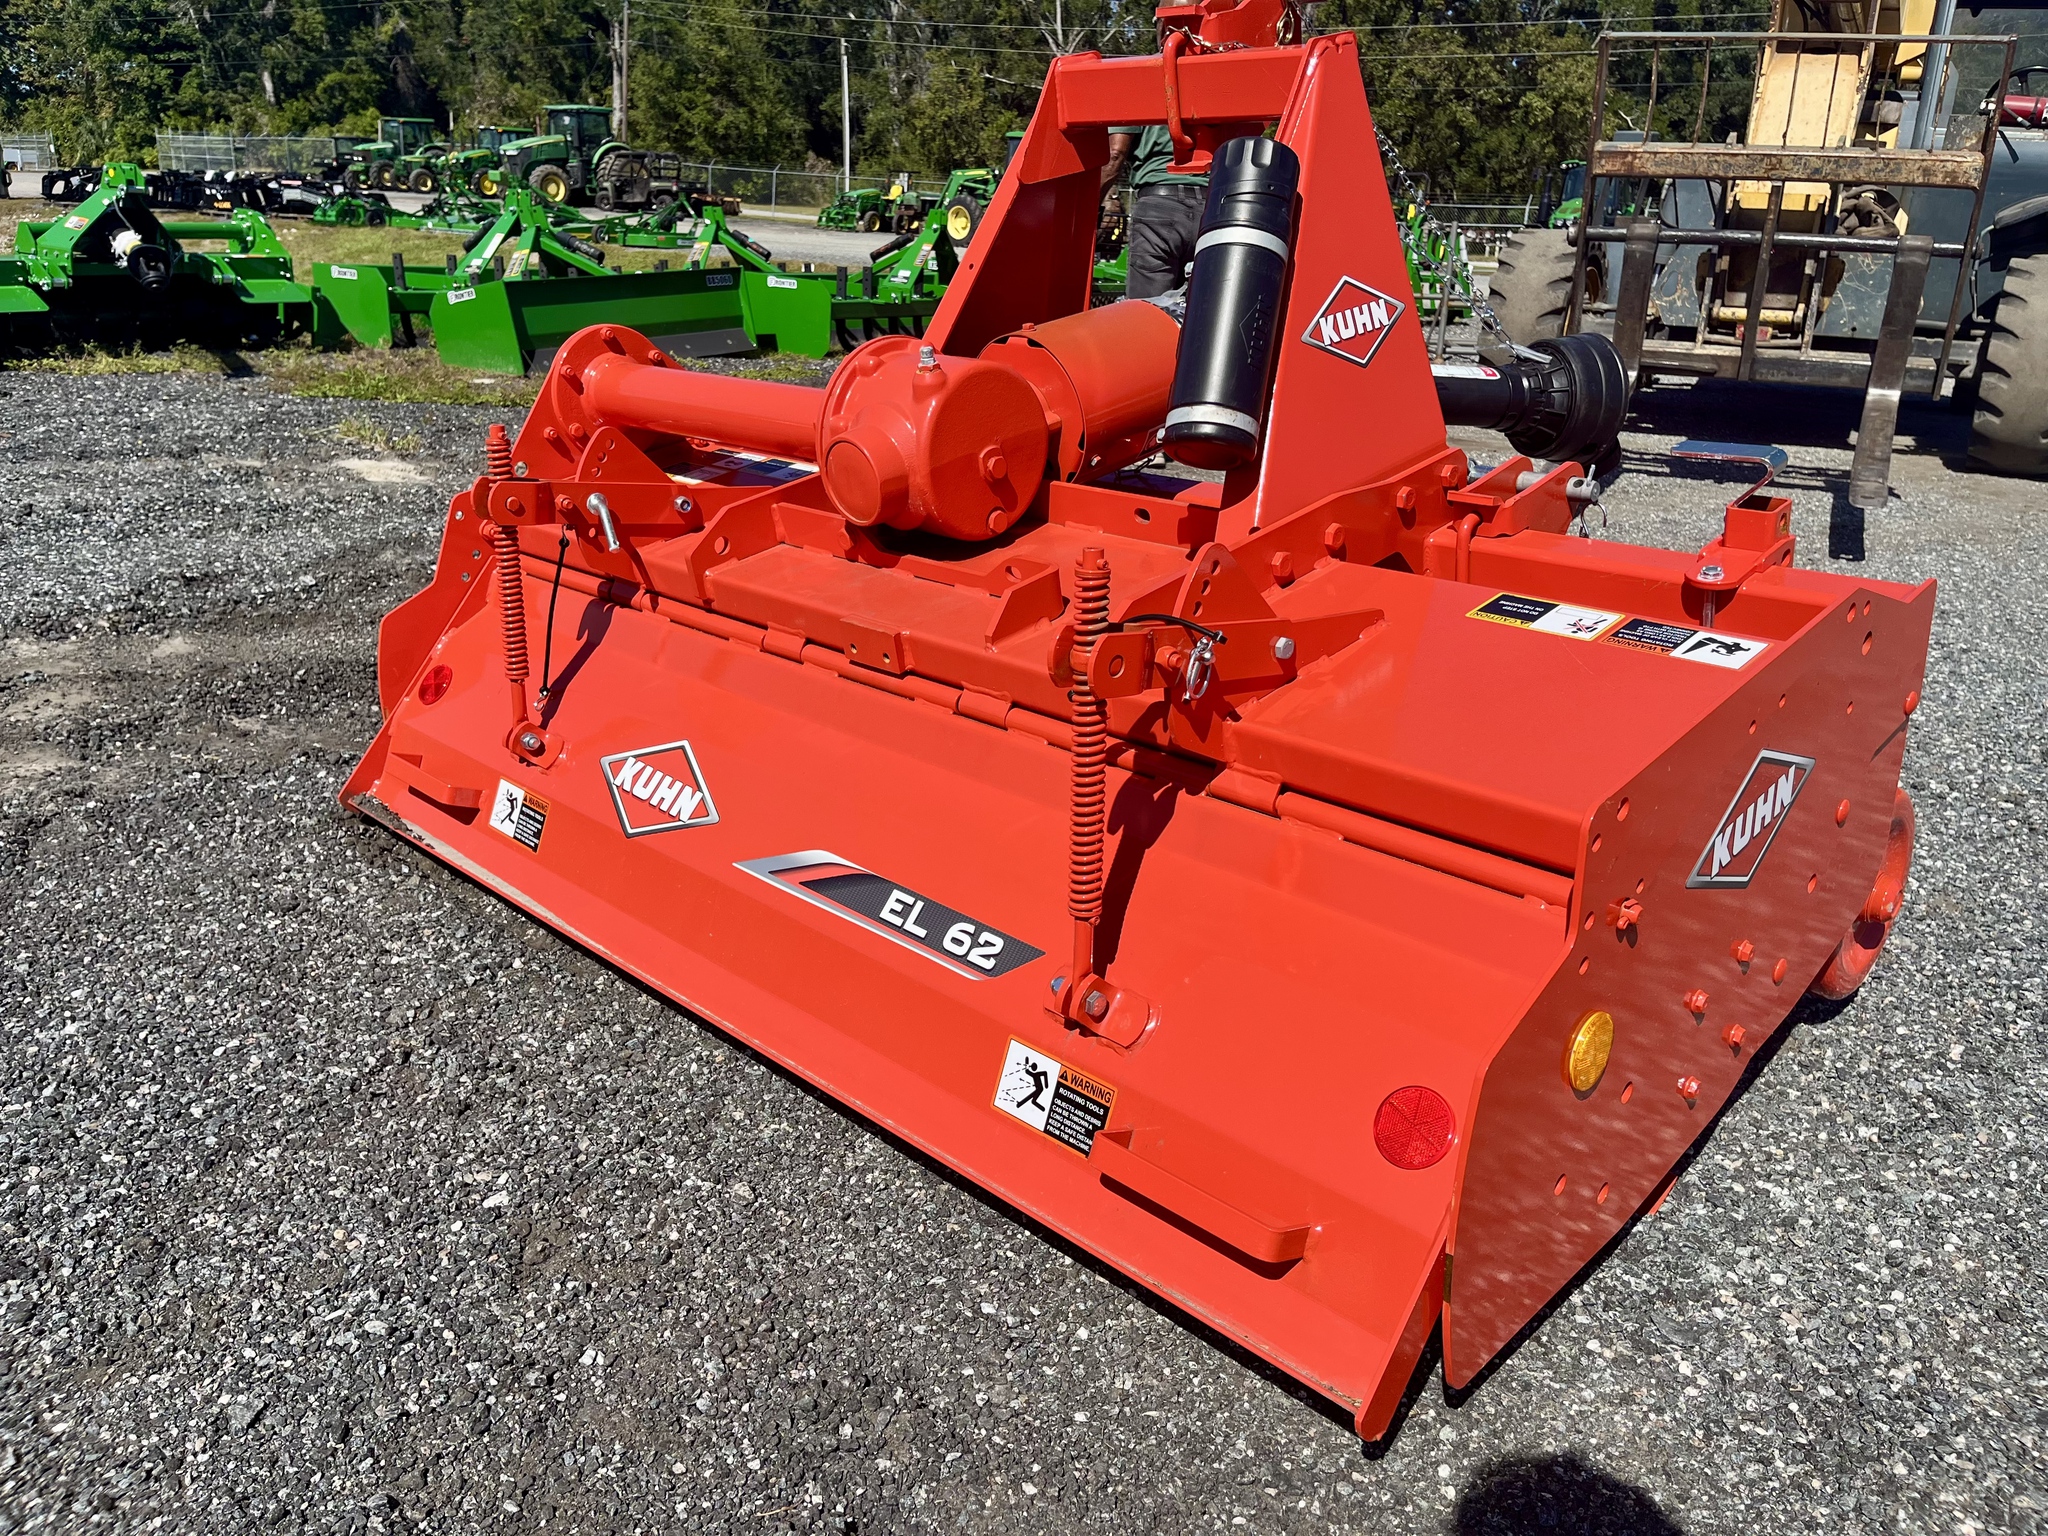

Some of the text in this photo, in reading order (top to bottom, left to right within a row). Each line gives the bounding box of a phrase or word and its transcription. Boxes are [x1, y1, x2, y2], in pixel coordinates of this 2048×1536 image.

[1319, 299, 1389, 346] KUHN
[1474, 612, 1517, 624] CAUTION
[1606, 637, 1657, 652] WARNING
[613, 756, 703, 823] KUHN
[528, 795, 548, 813] WARNING
[1711, 764, 1795, 879] KUHN
[879, 889, 1004, 970] EL 62
[1070, 1072, 1112, 1103] WARNING
[1054, 1098, 1102, 1127] OBJECTS AND DEBRIS
[1059, 1087, 1104, 1115] ROTATING TOOLS
[1048, 1119, 1061, 1129] KEEP
[1064, 1125, 1076, 1137] SAFE
[1050, 1111, 1063, 1122] LONG
[1052, 1104, 1062, 1114] CAN
[1062, 1110, 1069, 1118] BE
[1069, 1113, 1088, 1128] THROWN
[1046, 1125, 1060, 1136] FROM
[1060, 1131, 1070, 1140] THE
